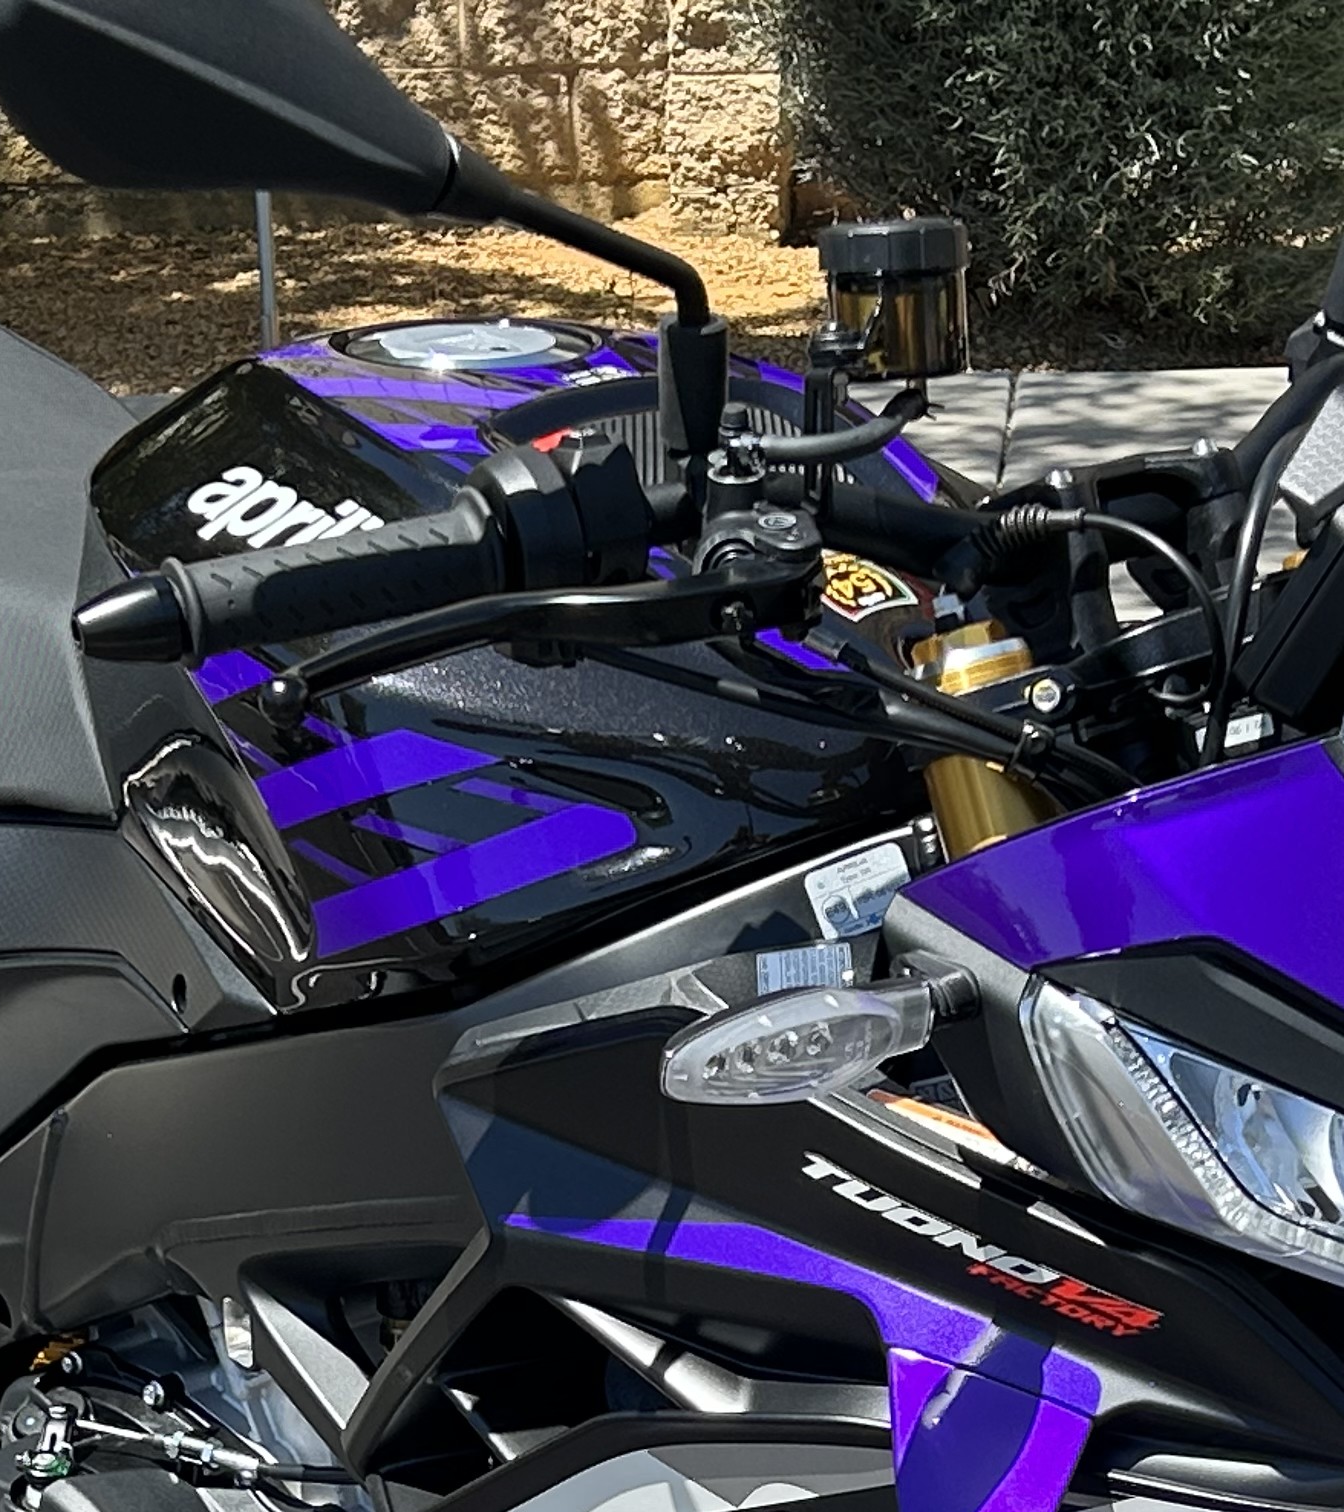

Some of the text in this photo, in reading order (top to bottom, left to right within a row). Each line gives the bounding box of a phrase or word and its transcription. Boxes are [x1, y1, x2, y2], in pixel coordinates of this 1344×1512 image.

[187, 466, 385, 549] april
[801, 1150, 1164, 1329] TUONO V4
[966, 1262, 1143, 1338] FACTORY
